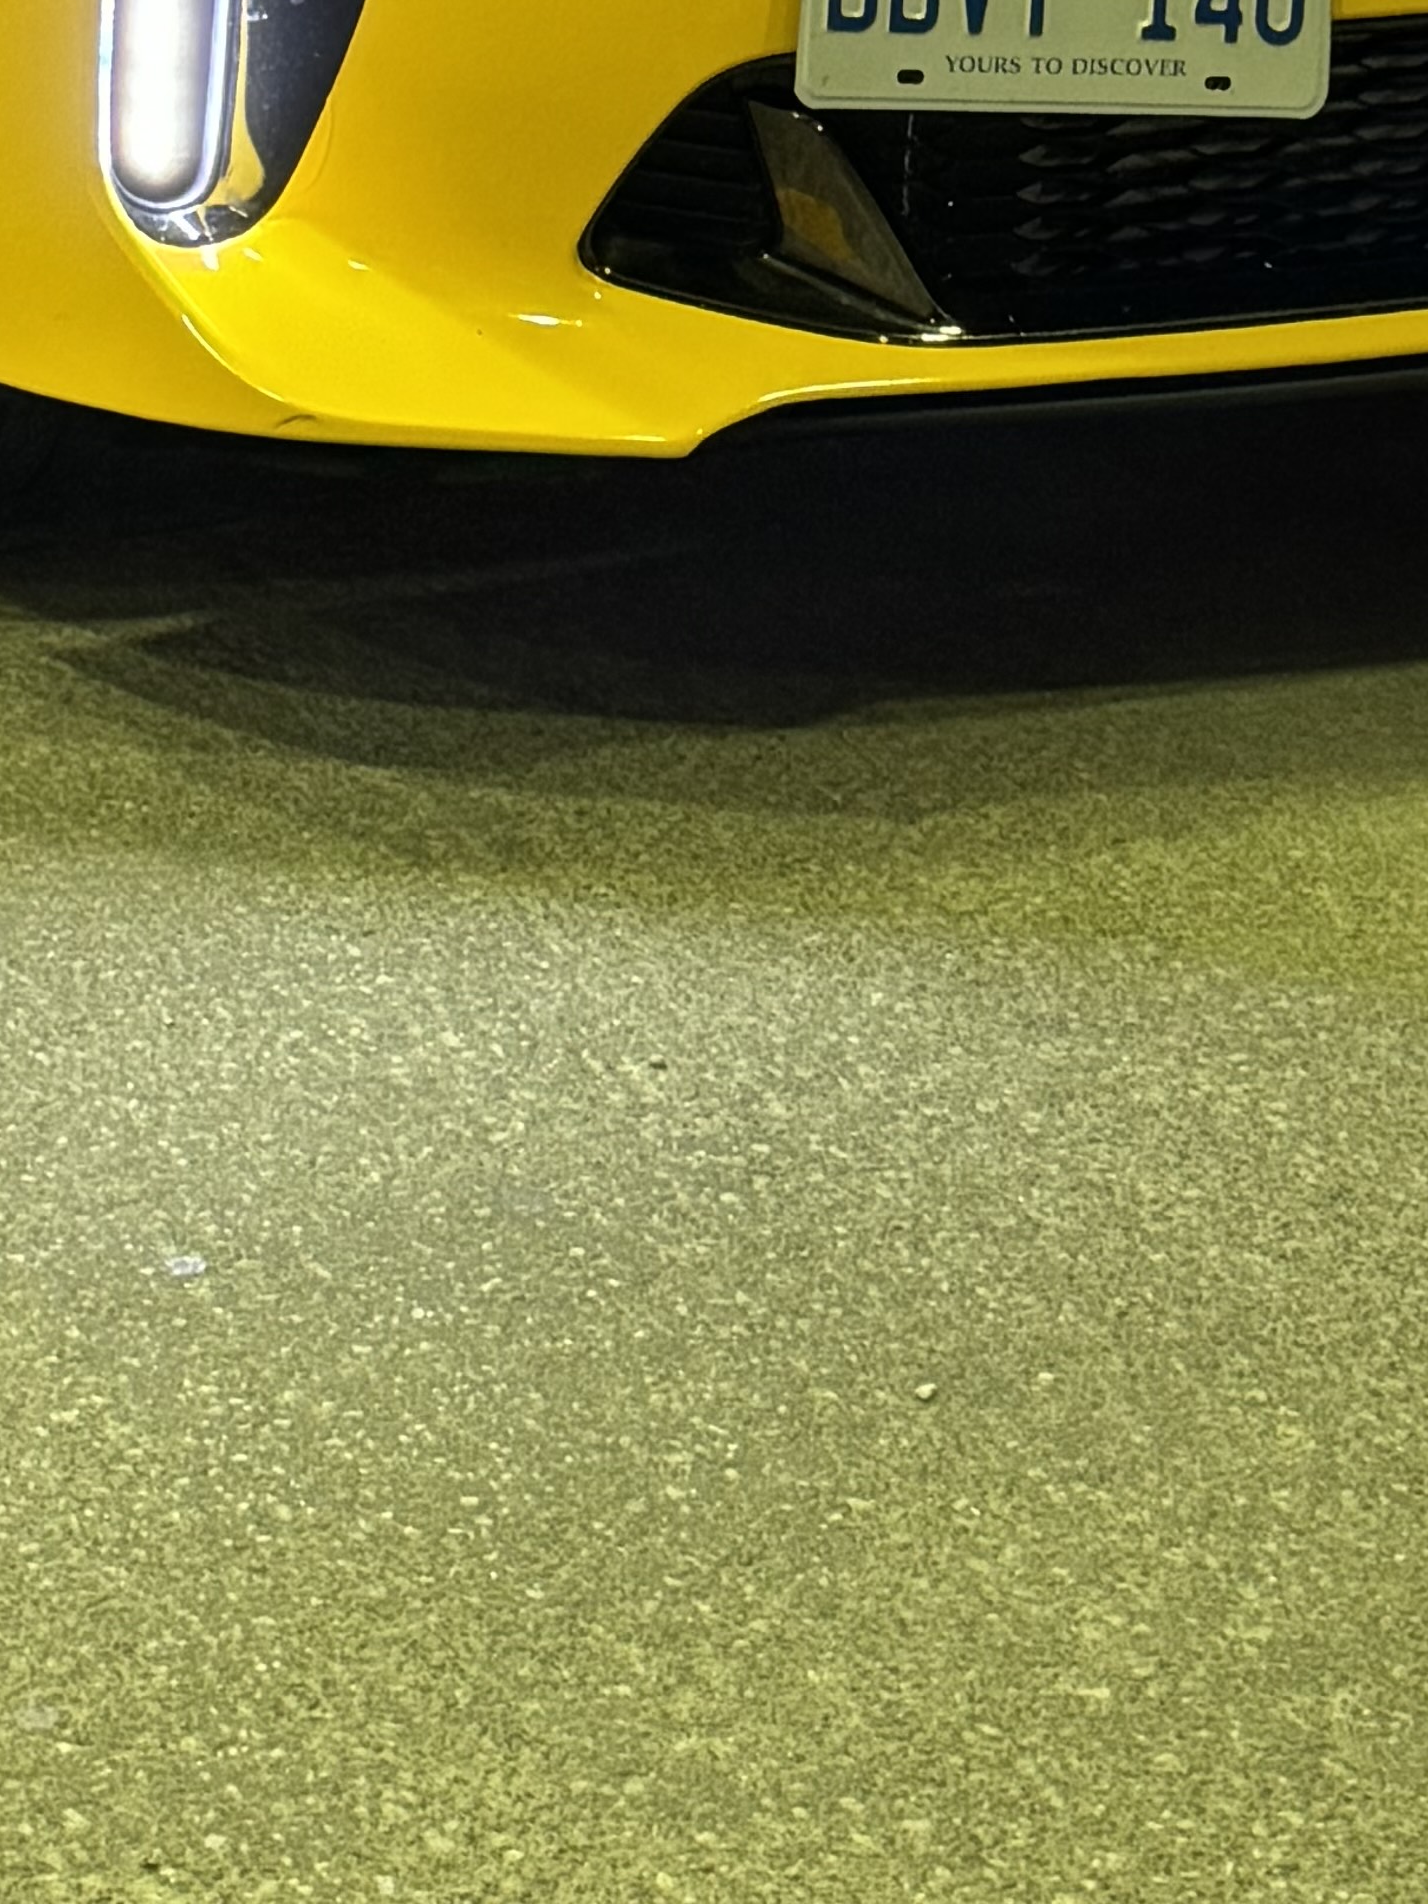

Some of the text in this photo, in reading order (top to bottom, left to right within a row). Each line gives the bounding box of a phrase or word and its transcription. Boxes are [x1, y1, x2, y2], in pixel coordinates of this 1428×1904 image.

[945, 54, 1188, 78] YOURS TO DISCOVER
